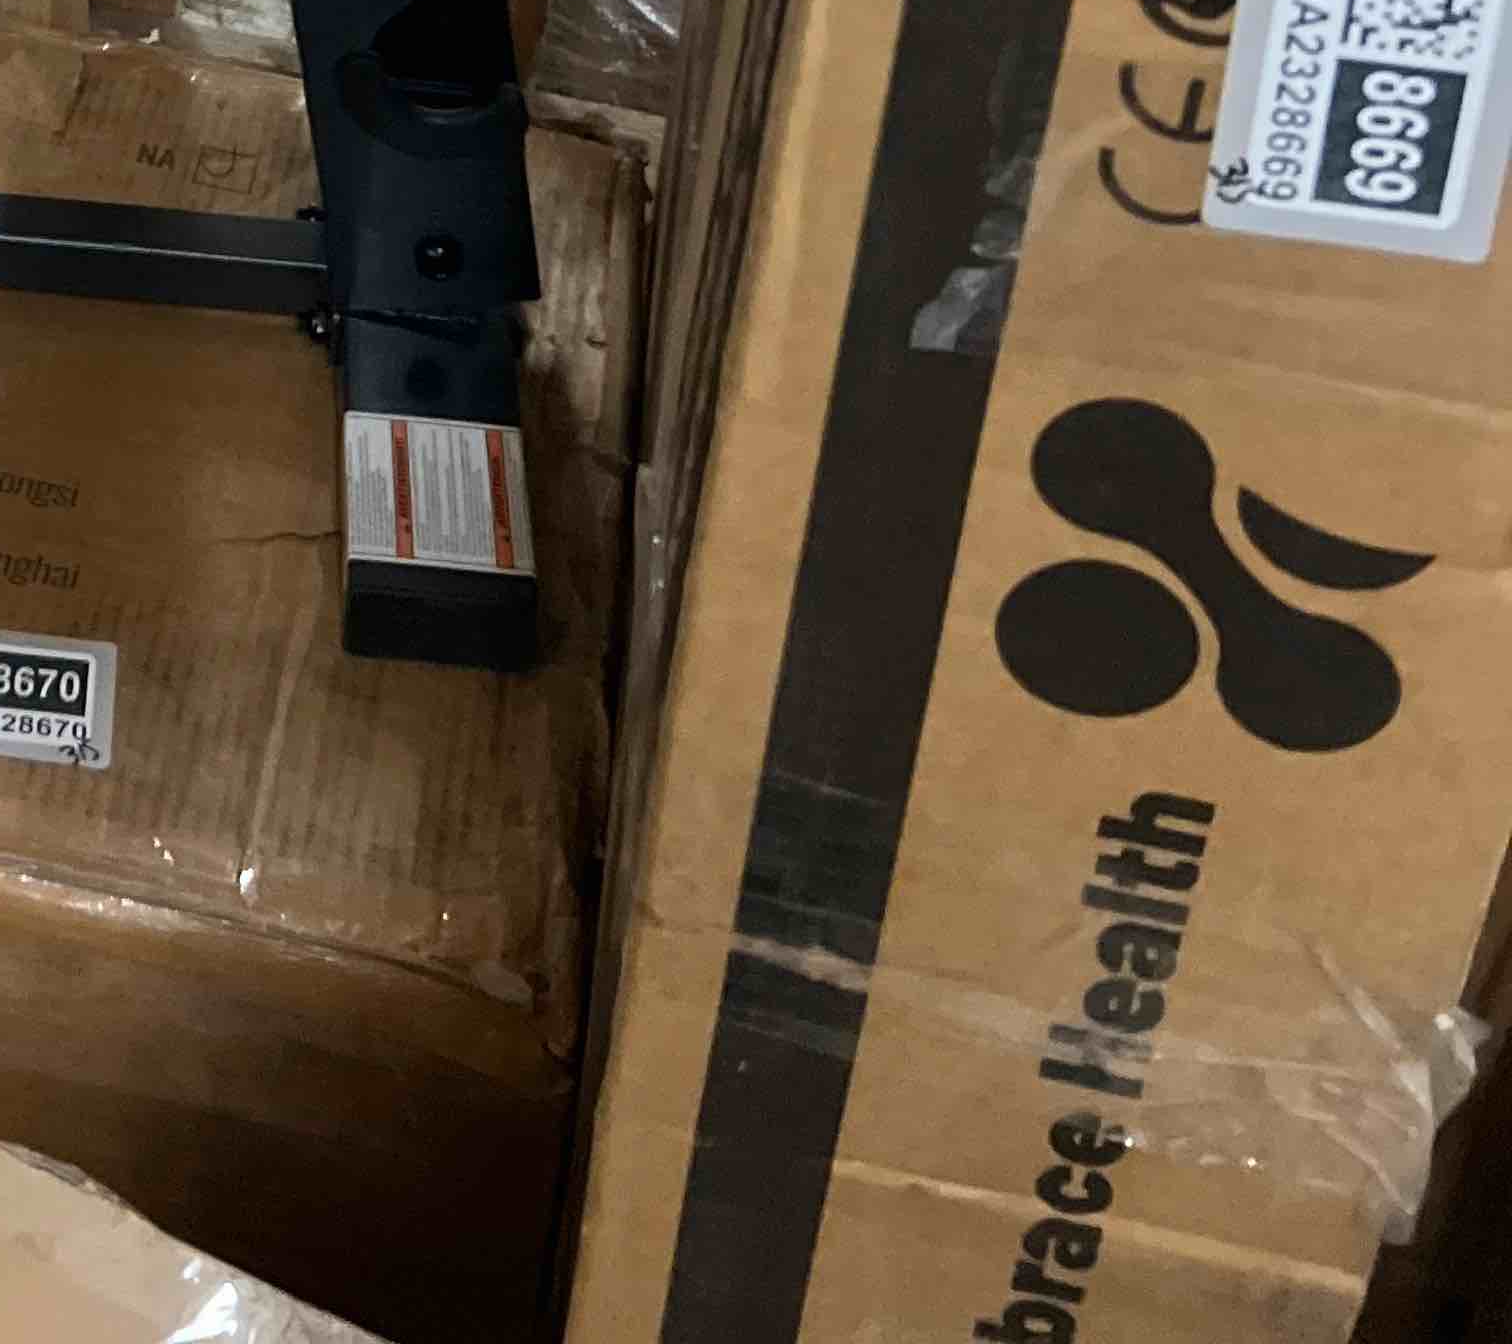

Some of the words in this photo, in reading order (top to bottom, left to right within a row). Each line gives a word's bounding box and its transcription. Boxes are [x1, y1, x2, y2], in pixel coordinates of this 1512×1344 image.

[136, 142, 175, 171] NA
[1346, 70, 1437, 206] 8669
[1037, 787, 1217, 1102] Health
